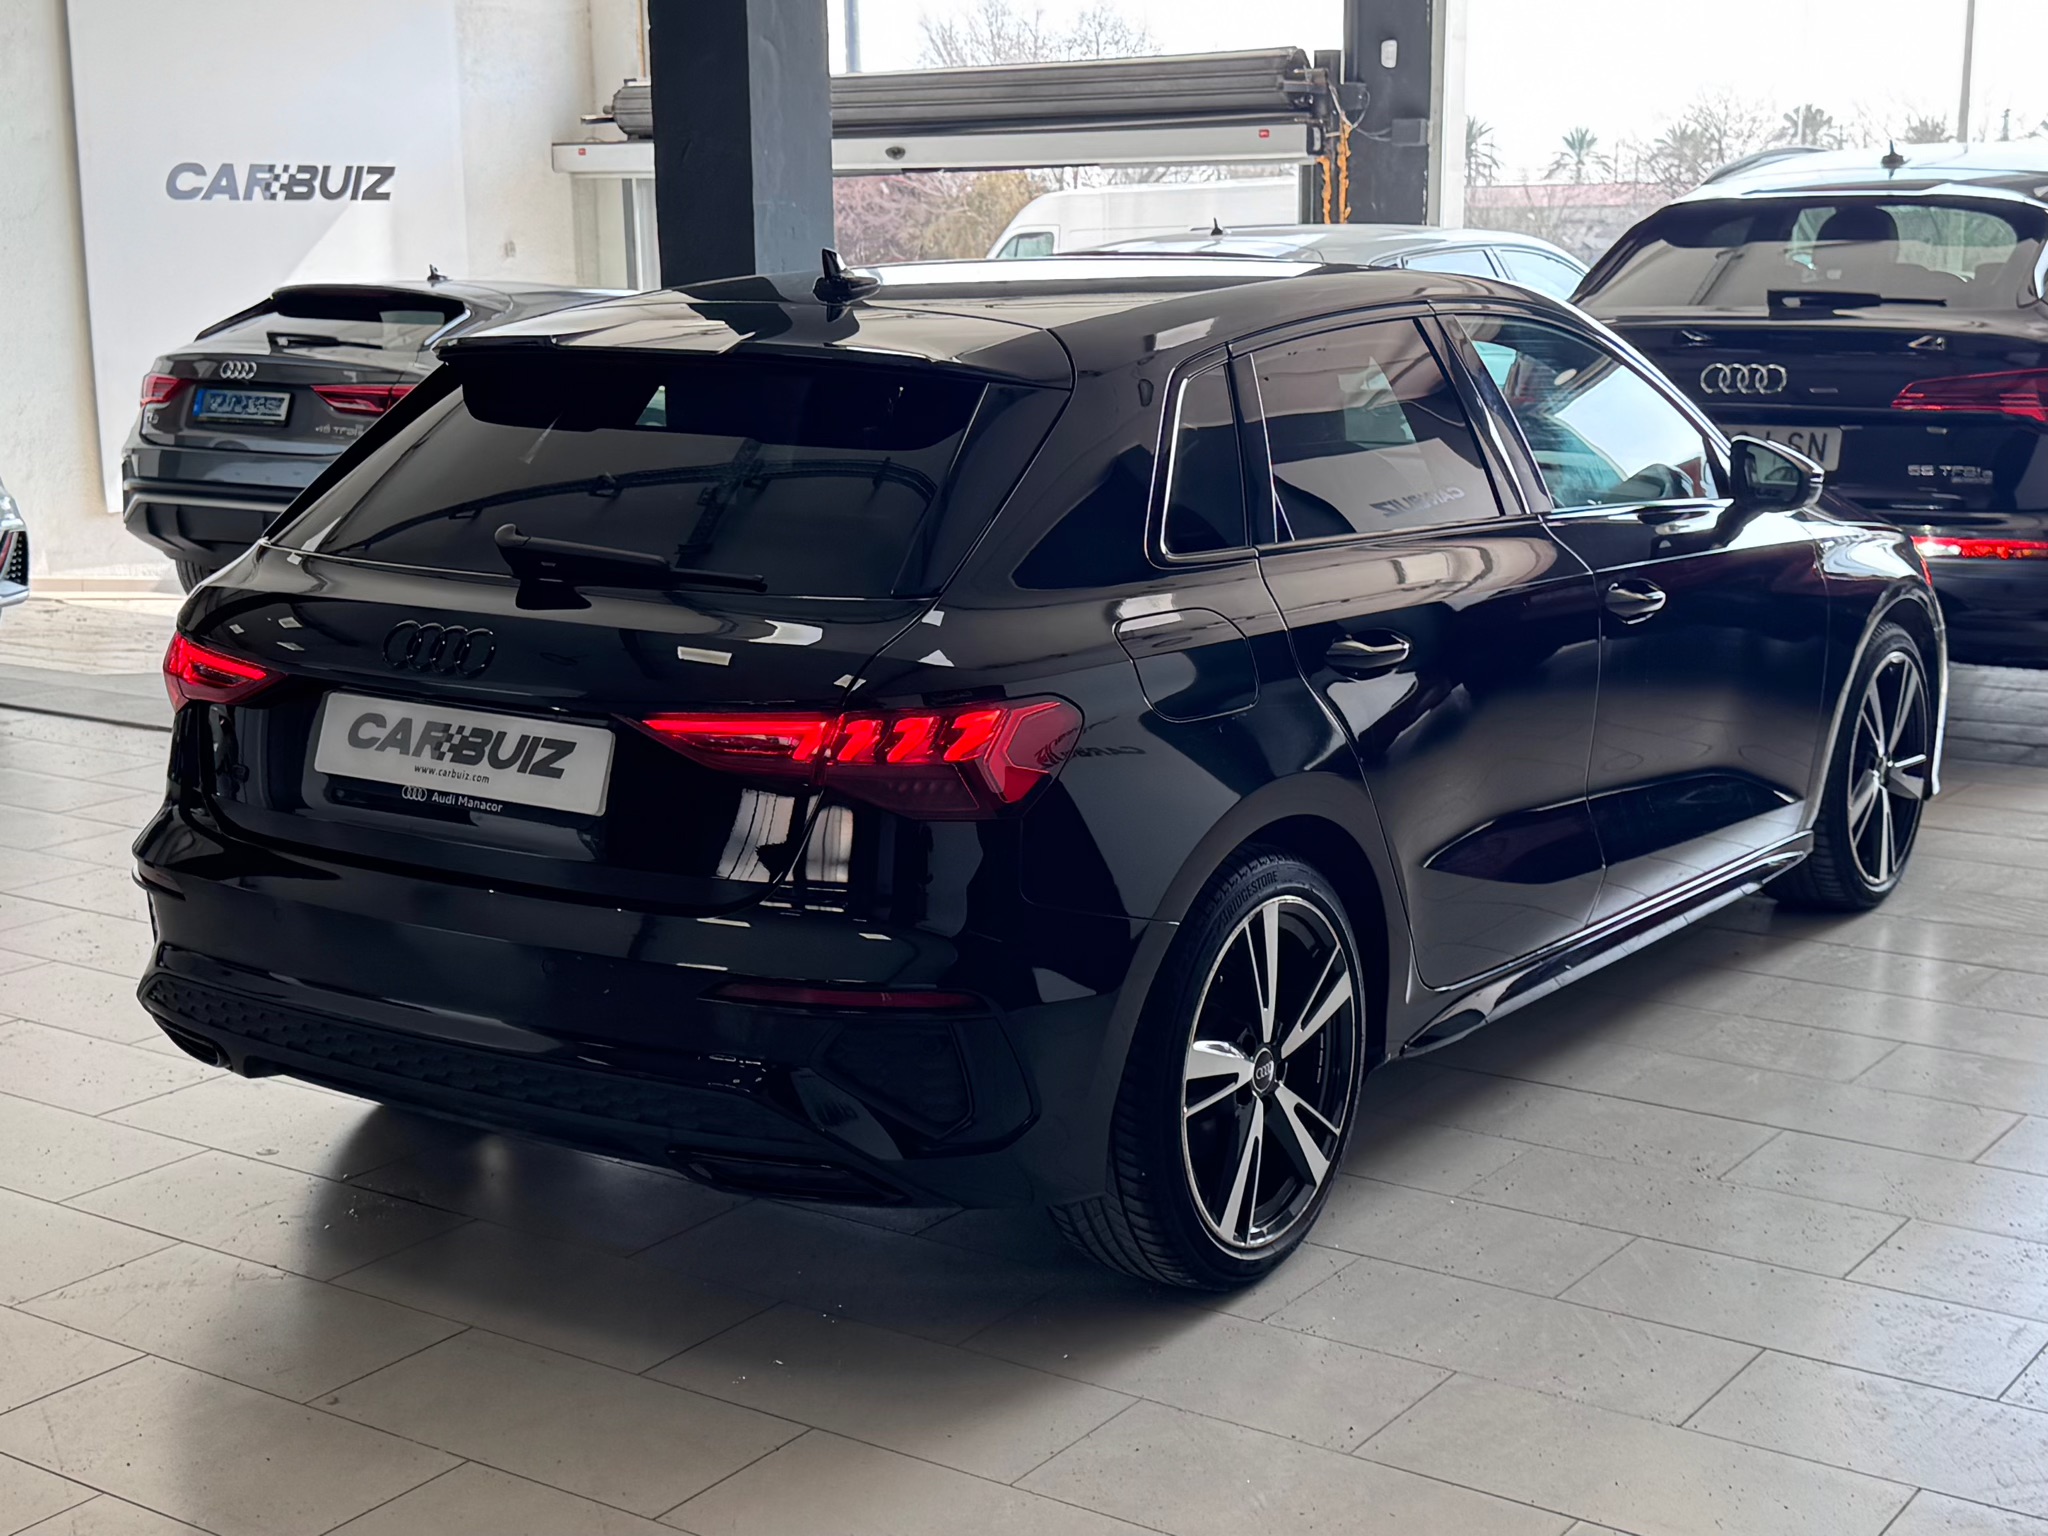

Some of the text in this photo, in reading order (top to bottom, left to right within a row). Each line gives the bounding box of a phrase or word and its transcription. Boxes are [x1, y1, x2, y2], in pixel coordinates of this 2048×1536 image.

[166, 162, 396, 201] CARBUIZ
[347, 712, 578, 780] CARBUIZ
[414, 765, 490, 784] www.carbuiz.com
[431, 792, 503, 812] Audi Manacor
